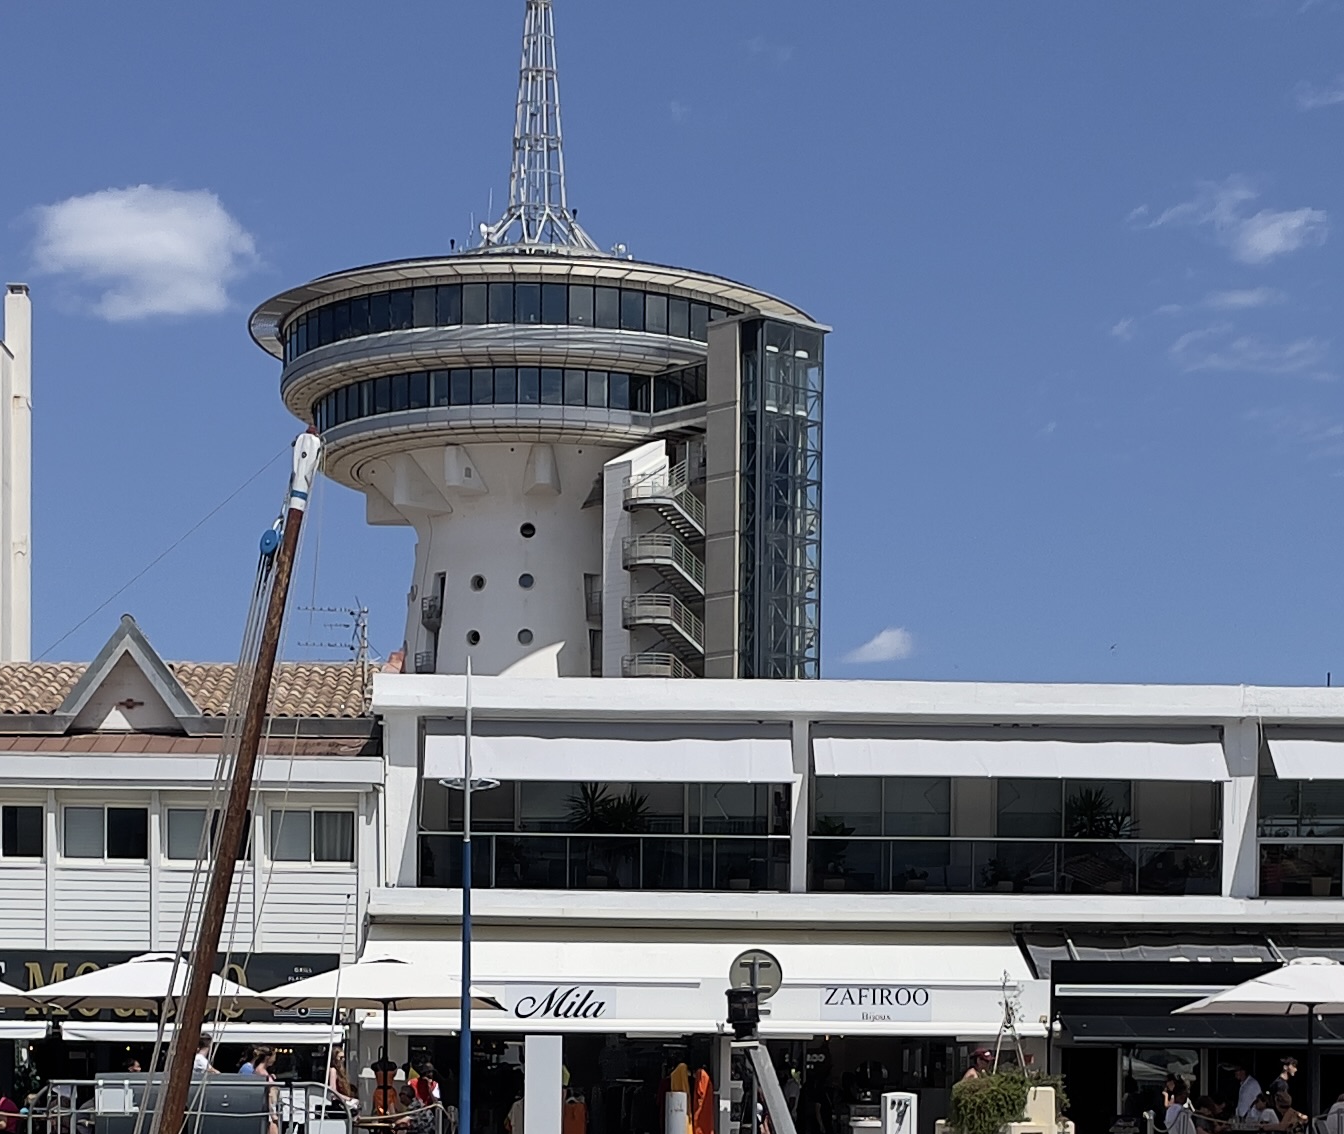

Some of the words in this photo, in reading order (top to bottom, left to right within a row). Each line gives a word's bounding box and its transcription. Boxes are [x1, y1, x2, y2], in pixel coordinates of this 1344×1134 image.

[514, 986, 606, 1018] Mila
[824, 987, 929, 1006] ZAFIROO
[861, 1012, 892, 1022] Bijoux
